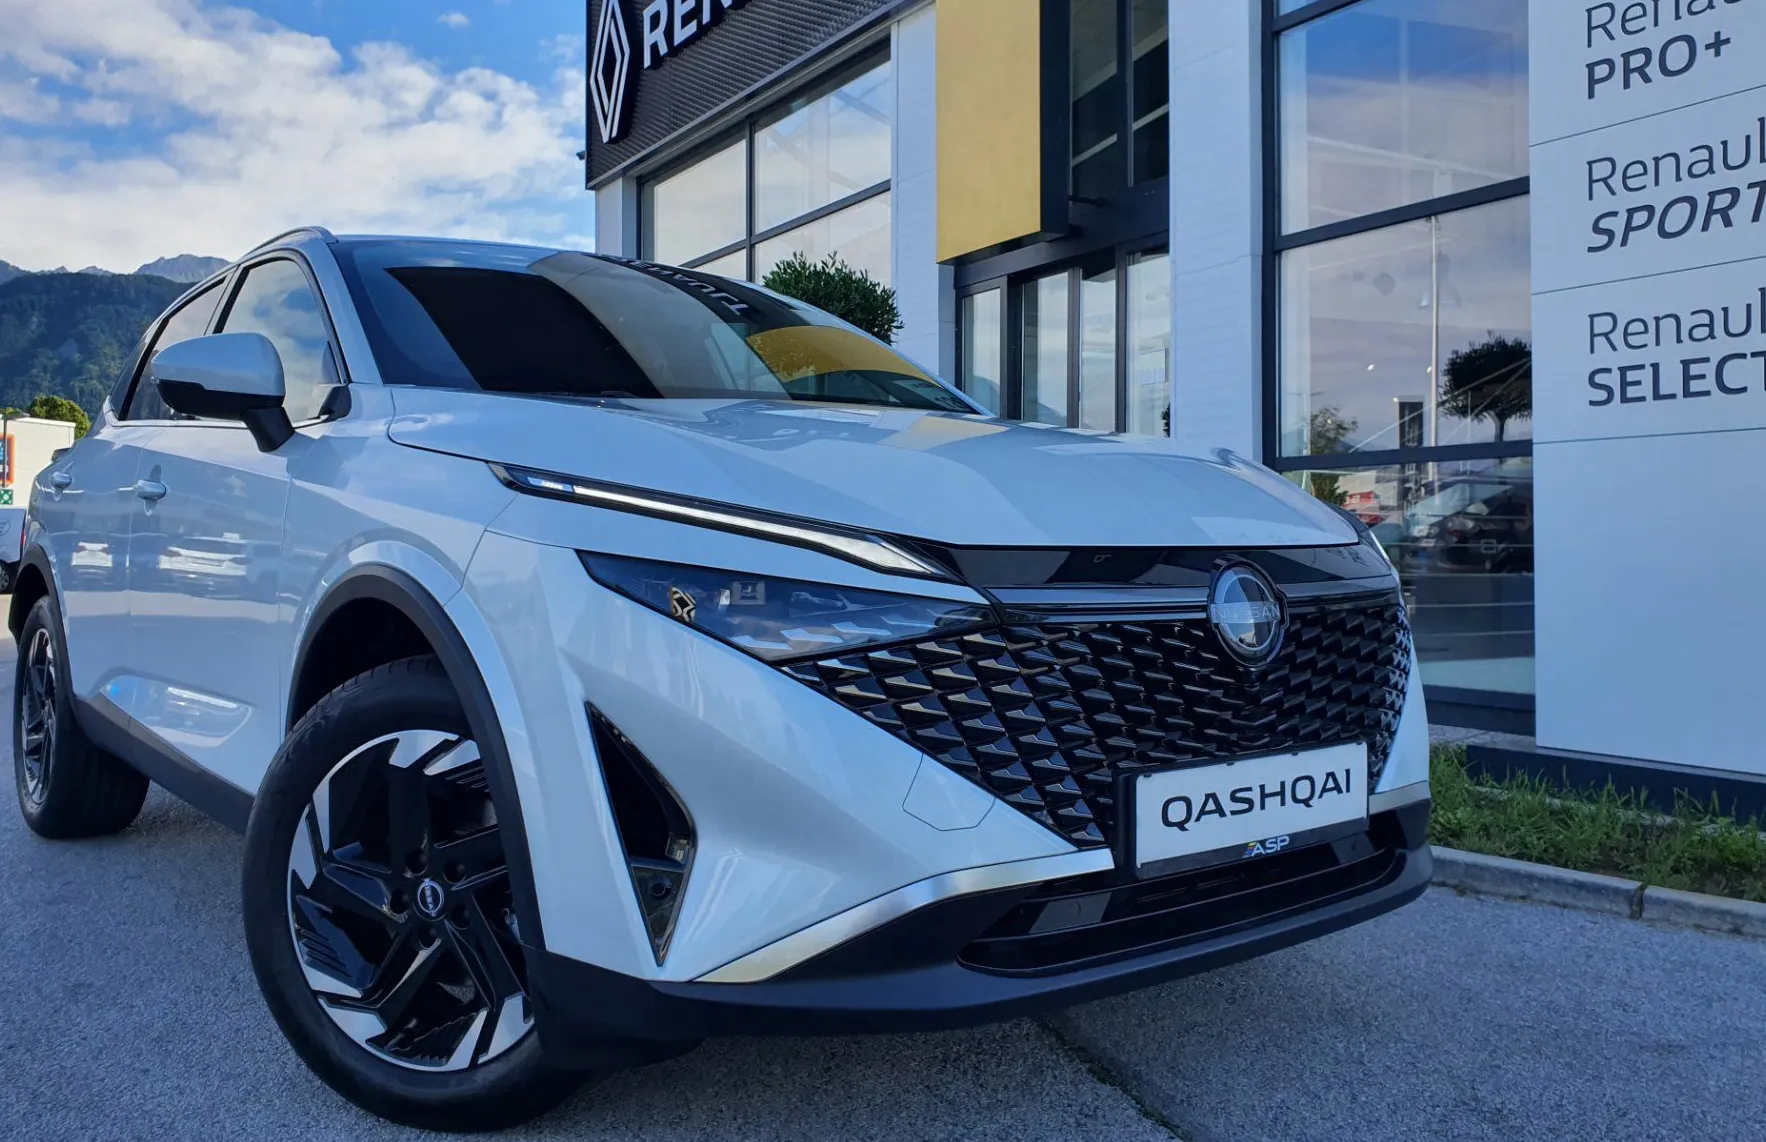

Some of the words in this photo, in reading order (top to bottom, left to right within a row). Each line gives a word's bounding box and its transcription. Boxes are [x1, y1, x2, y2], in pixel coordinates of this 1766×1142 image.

[1585, 31, 1731, 100] PRO+
[1587, 180, 1766, 253] SPORT
[1161, 768, 1351, 831] QASHQAI
[1249, 836, 1289, 857] ASP
